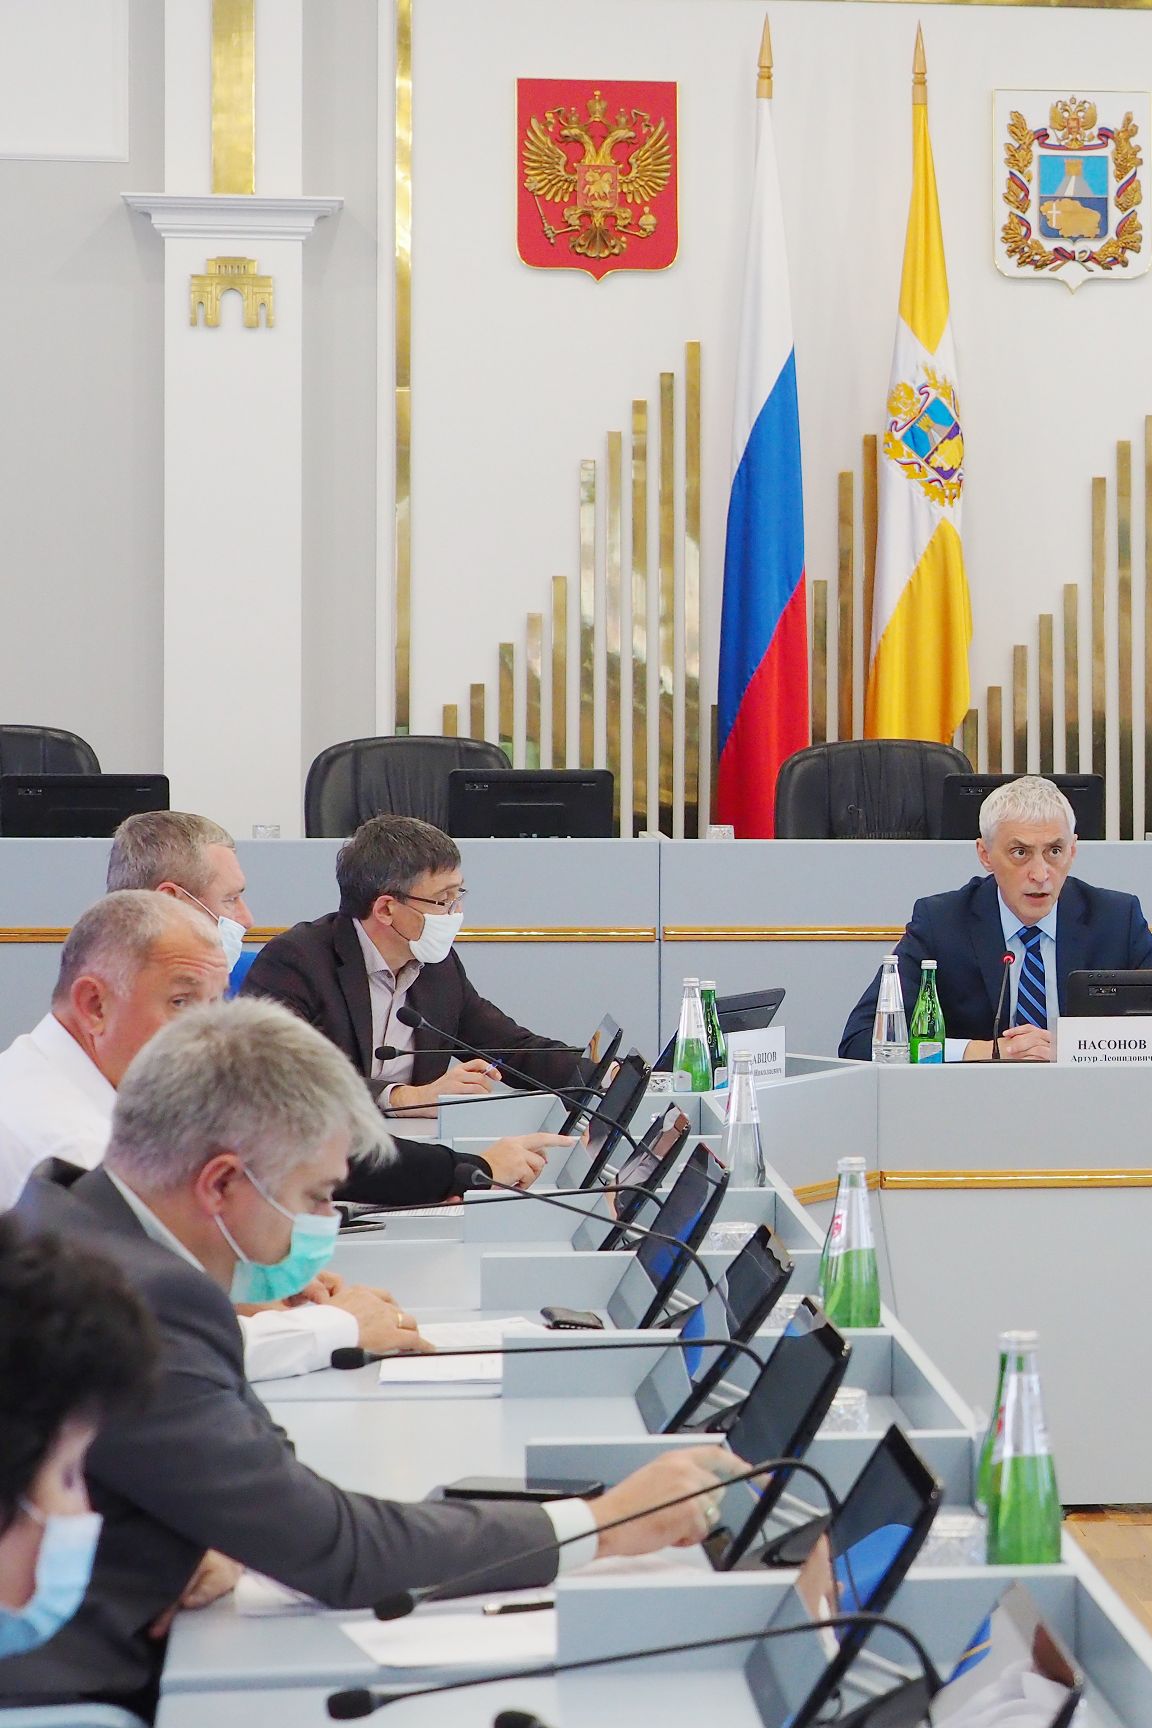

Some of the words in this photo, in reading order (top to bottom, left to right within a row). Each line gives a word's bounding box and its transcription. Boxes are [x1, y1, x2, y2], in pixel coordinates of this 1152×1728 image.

[1078, 1039, 1147, 1050] НАСОНОВ
[751, 1051, 777, 1066] АВЦОВ
[1071, 1055, 1098, 1064] Артур
